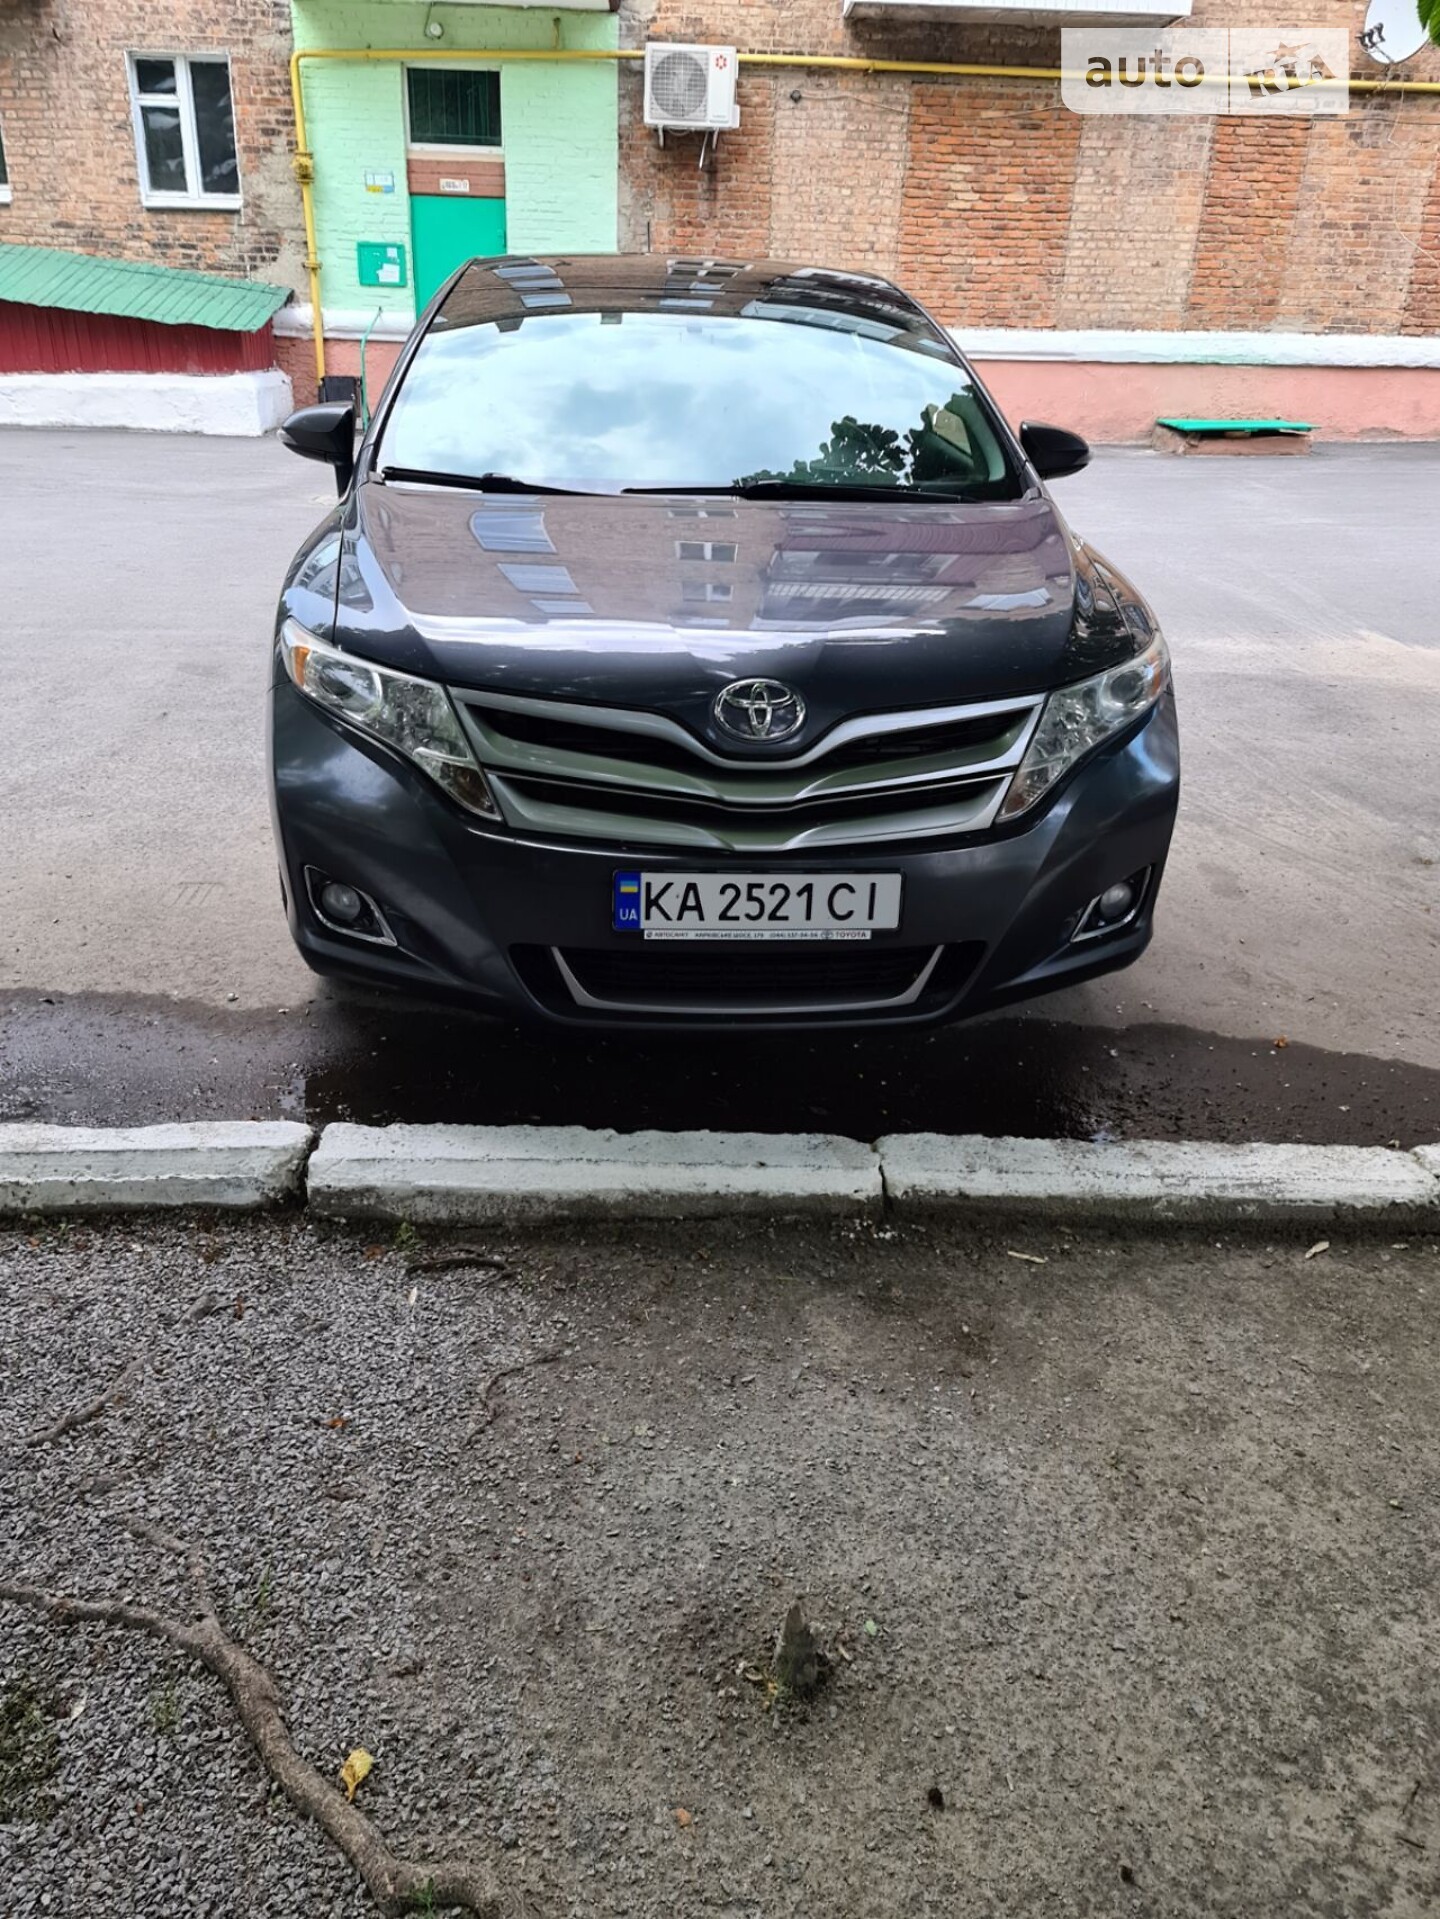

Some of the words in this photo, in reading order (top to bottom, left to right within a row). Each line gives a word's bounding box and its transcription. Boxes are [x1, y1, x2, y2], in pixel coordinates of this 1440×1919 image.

[619, 908, 638, 921] UA
[645, 882, 705, 921] KA
[718, 883, 814, 921] 2521
[827, 882, 877, 921] CI
